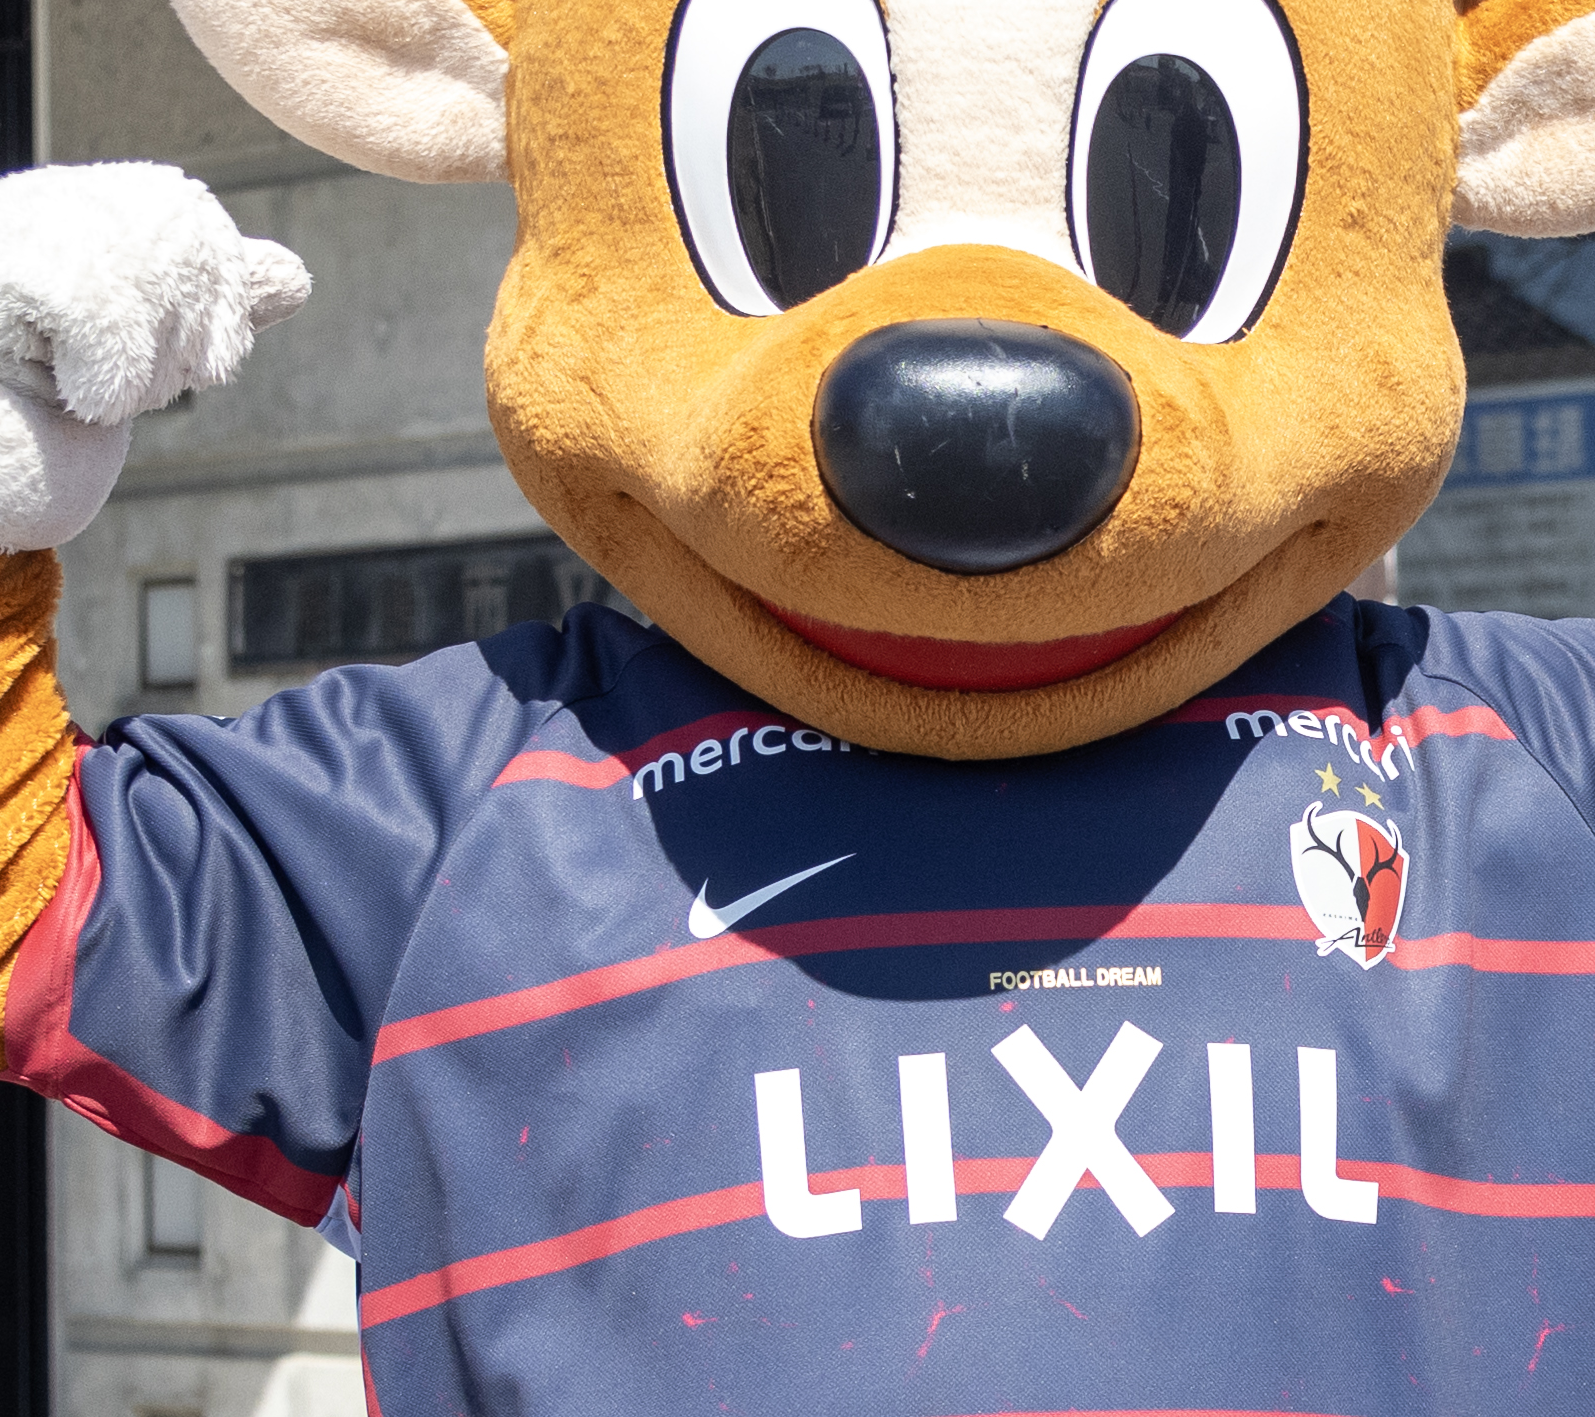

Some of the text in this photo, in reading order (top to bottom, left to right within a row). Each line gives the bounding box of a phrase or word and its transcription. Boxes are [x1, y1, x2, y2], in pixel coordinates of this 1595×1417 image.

[632, 724, 879, 800] merca
[989, 966, 1162, 990] FOOTBALL DREAM
[754, 1020, 1380, 1241] LIXIL
